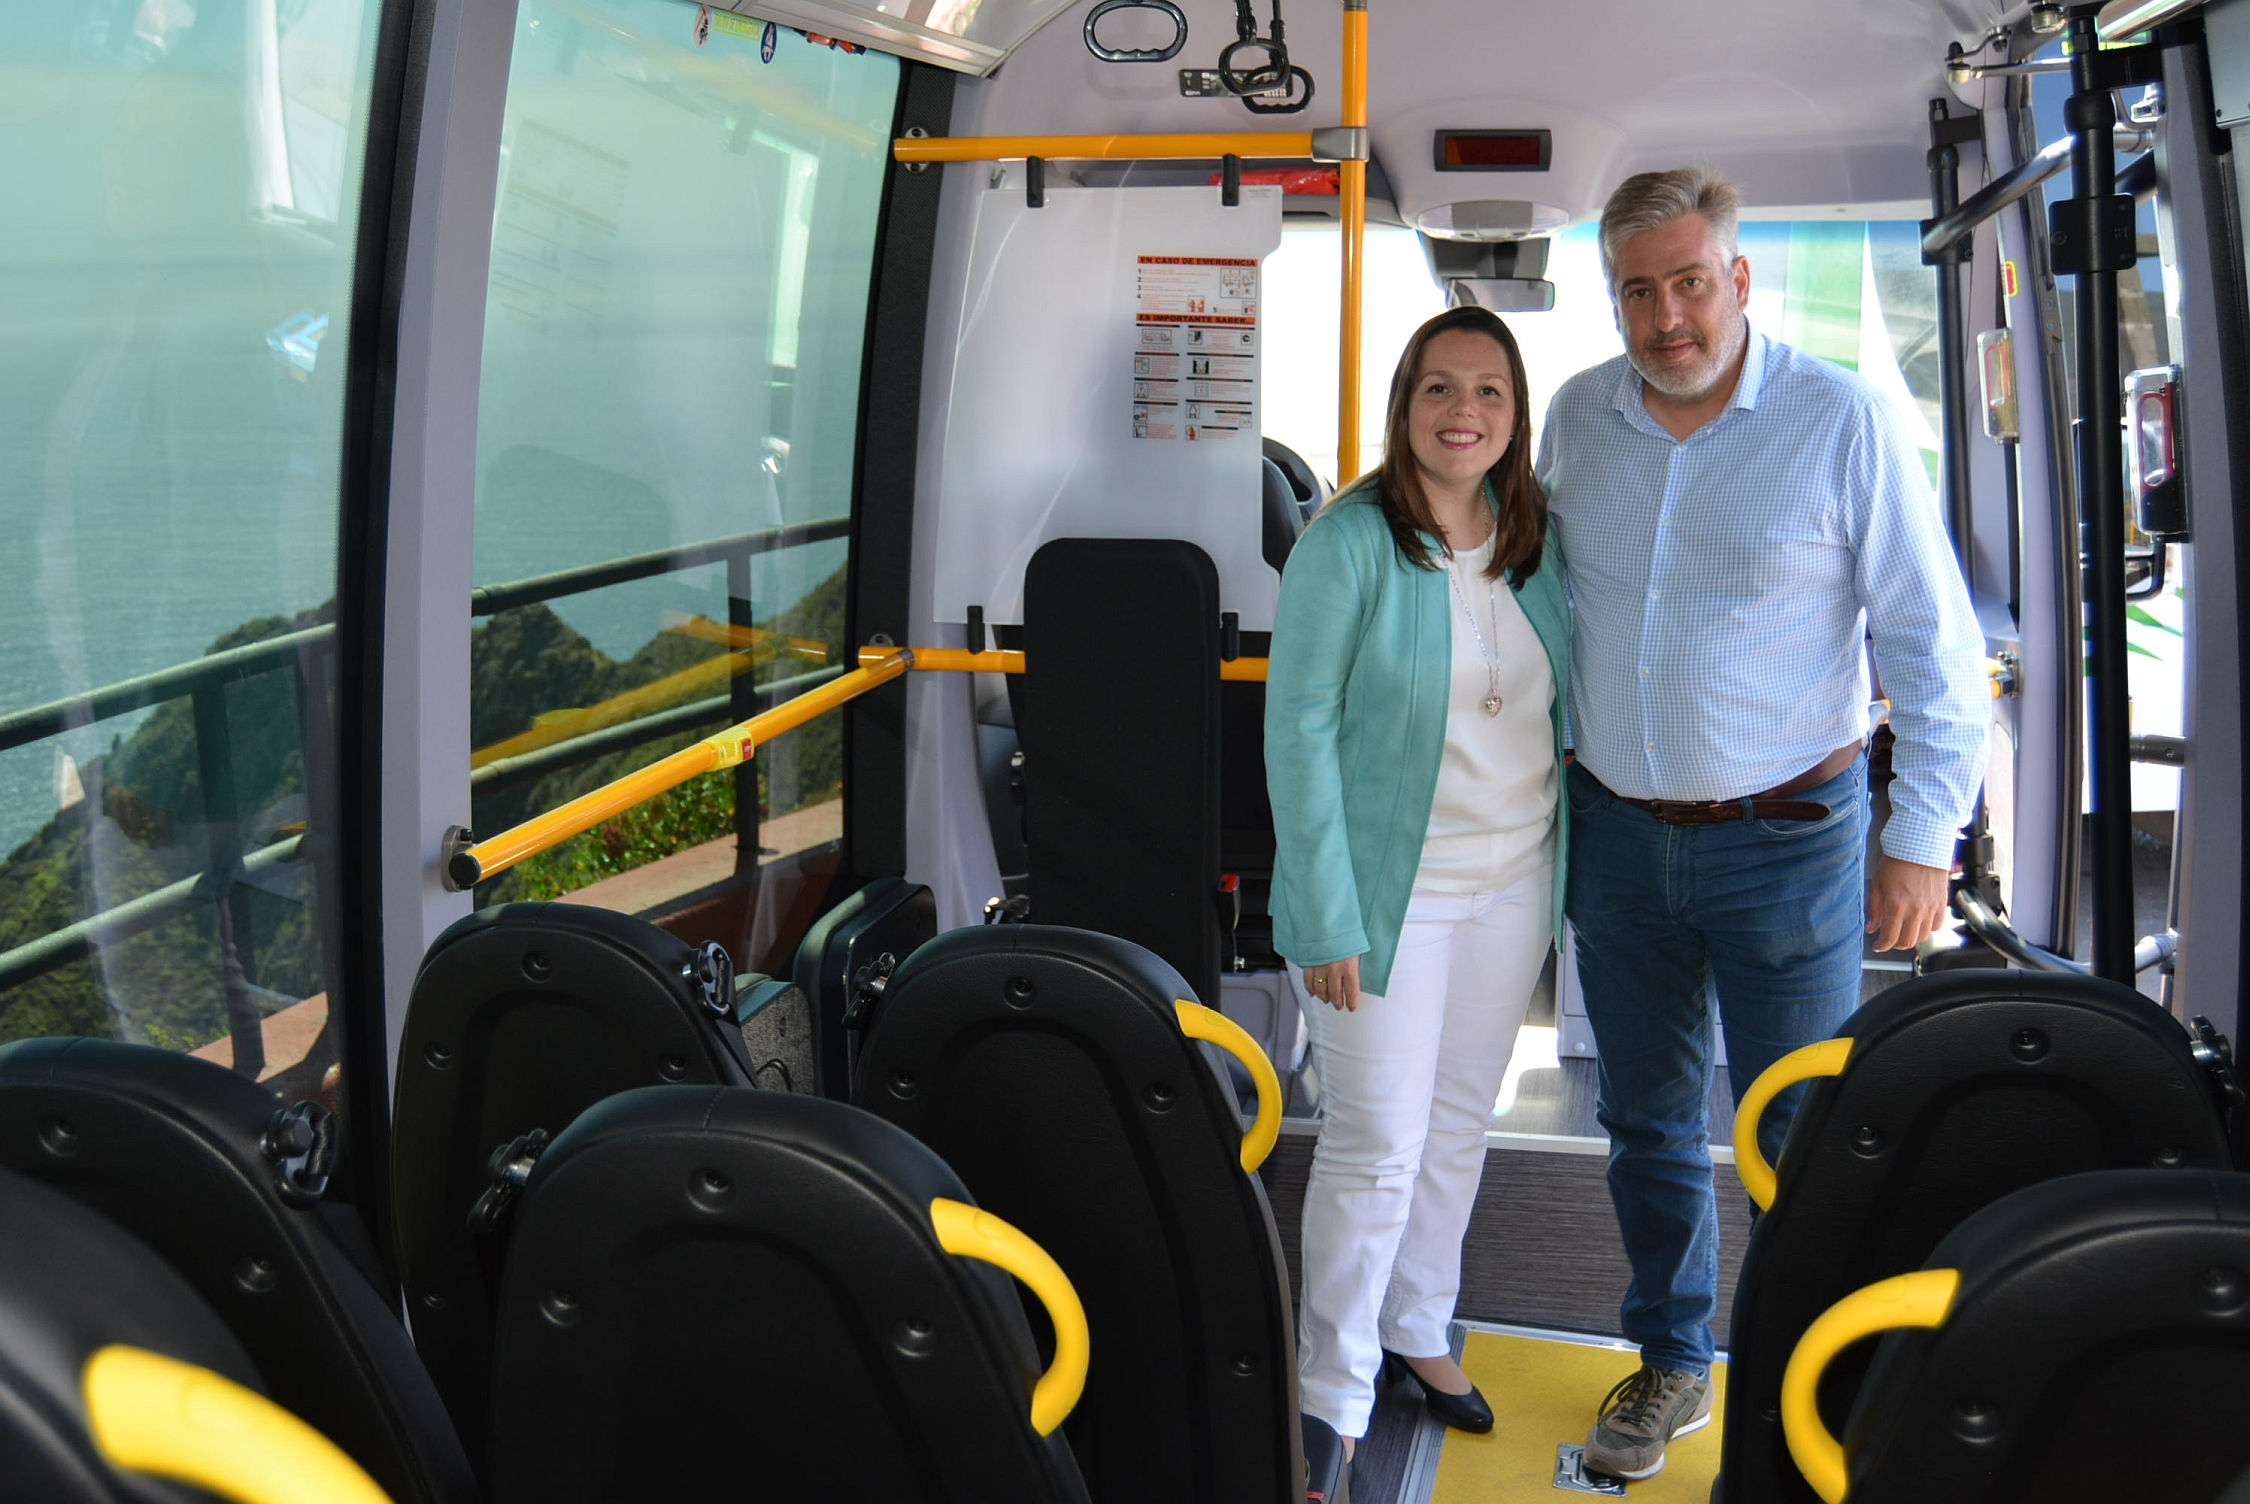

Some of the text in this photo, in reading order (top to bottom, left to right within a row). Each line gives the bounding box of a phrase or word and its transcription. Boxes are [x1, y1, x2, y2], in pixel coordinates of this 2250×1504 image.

[1155, 257, 1180, 265] CASO
[1196, 258, 1256, 267] EMERGENCIA
[1153, 315, 1212, 323] IMPORTANTE
